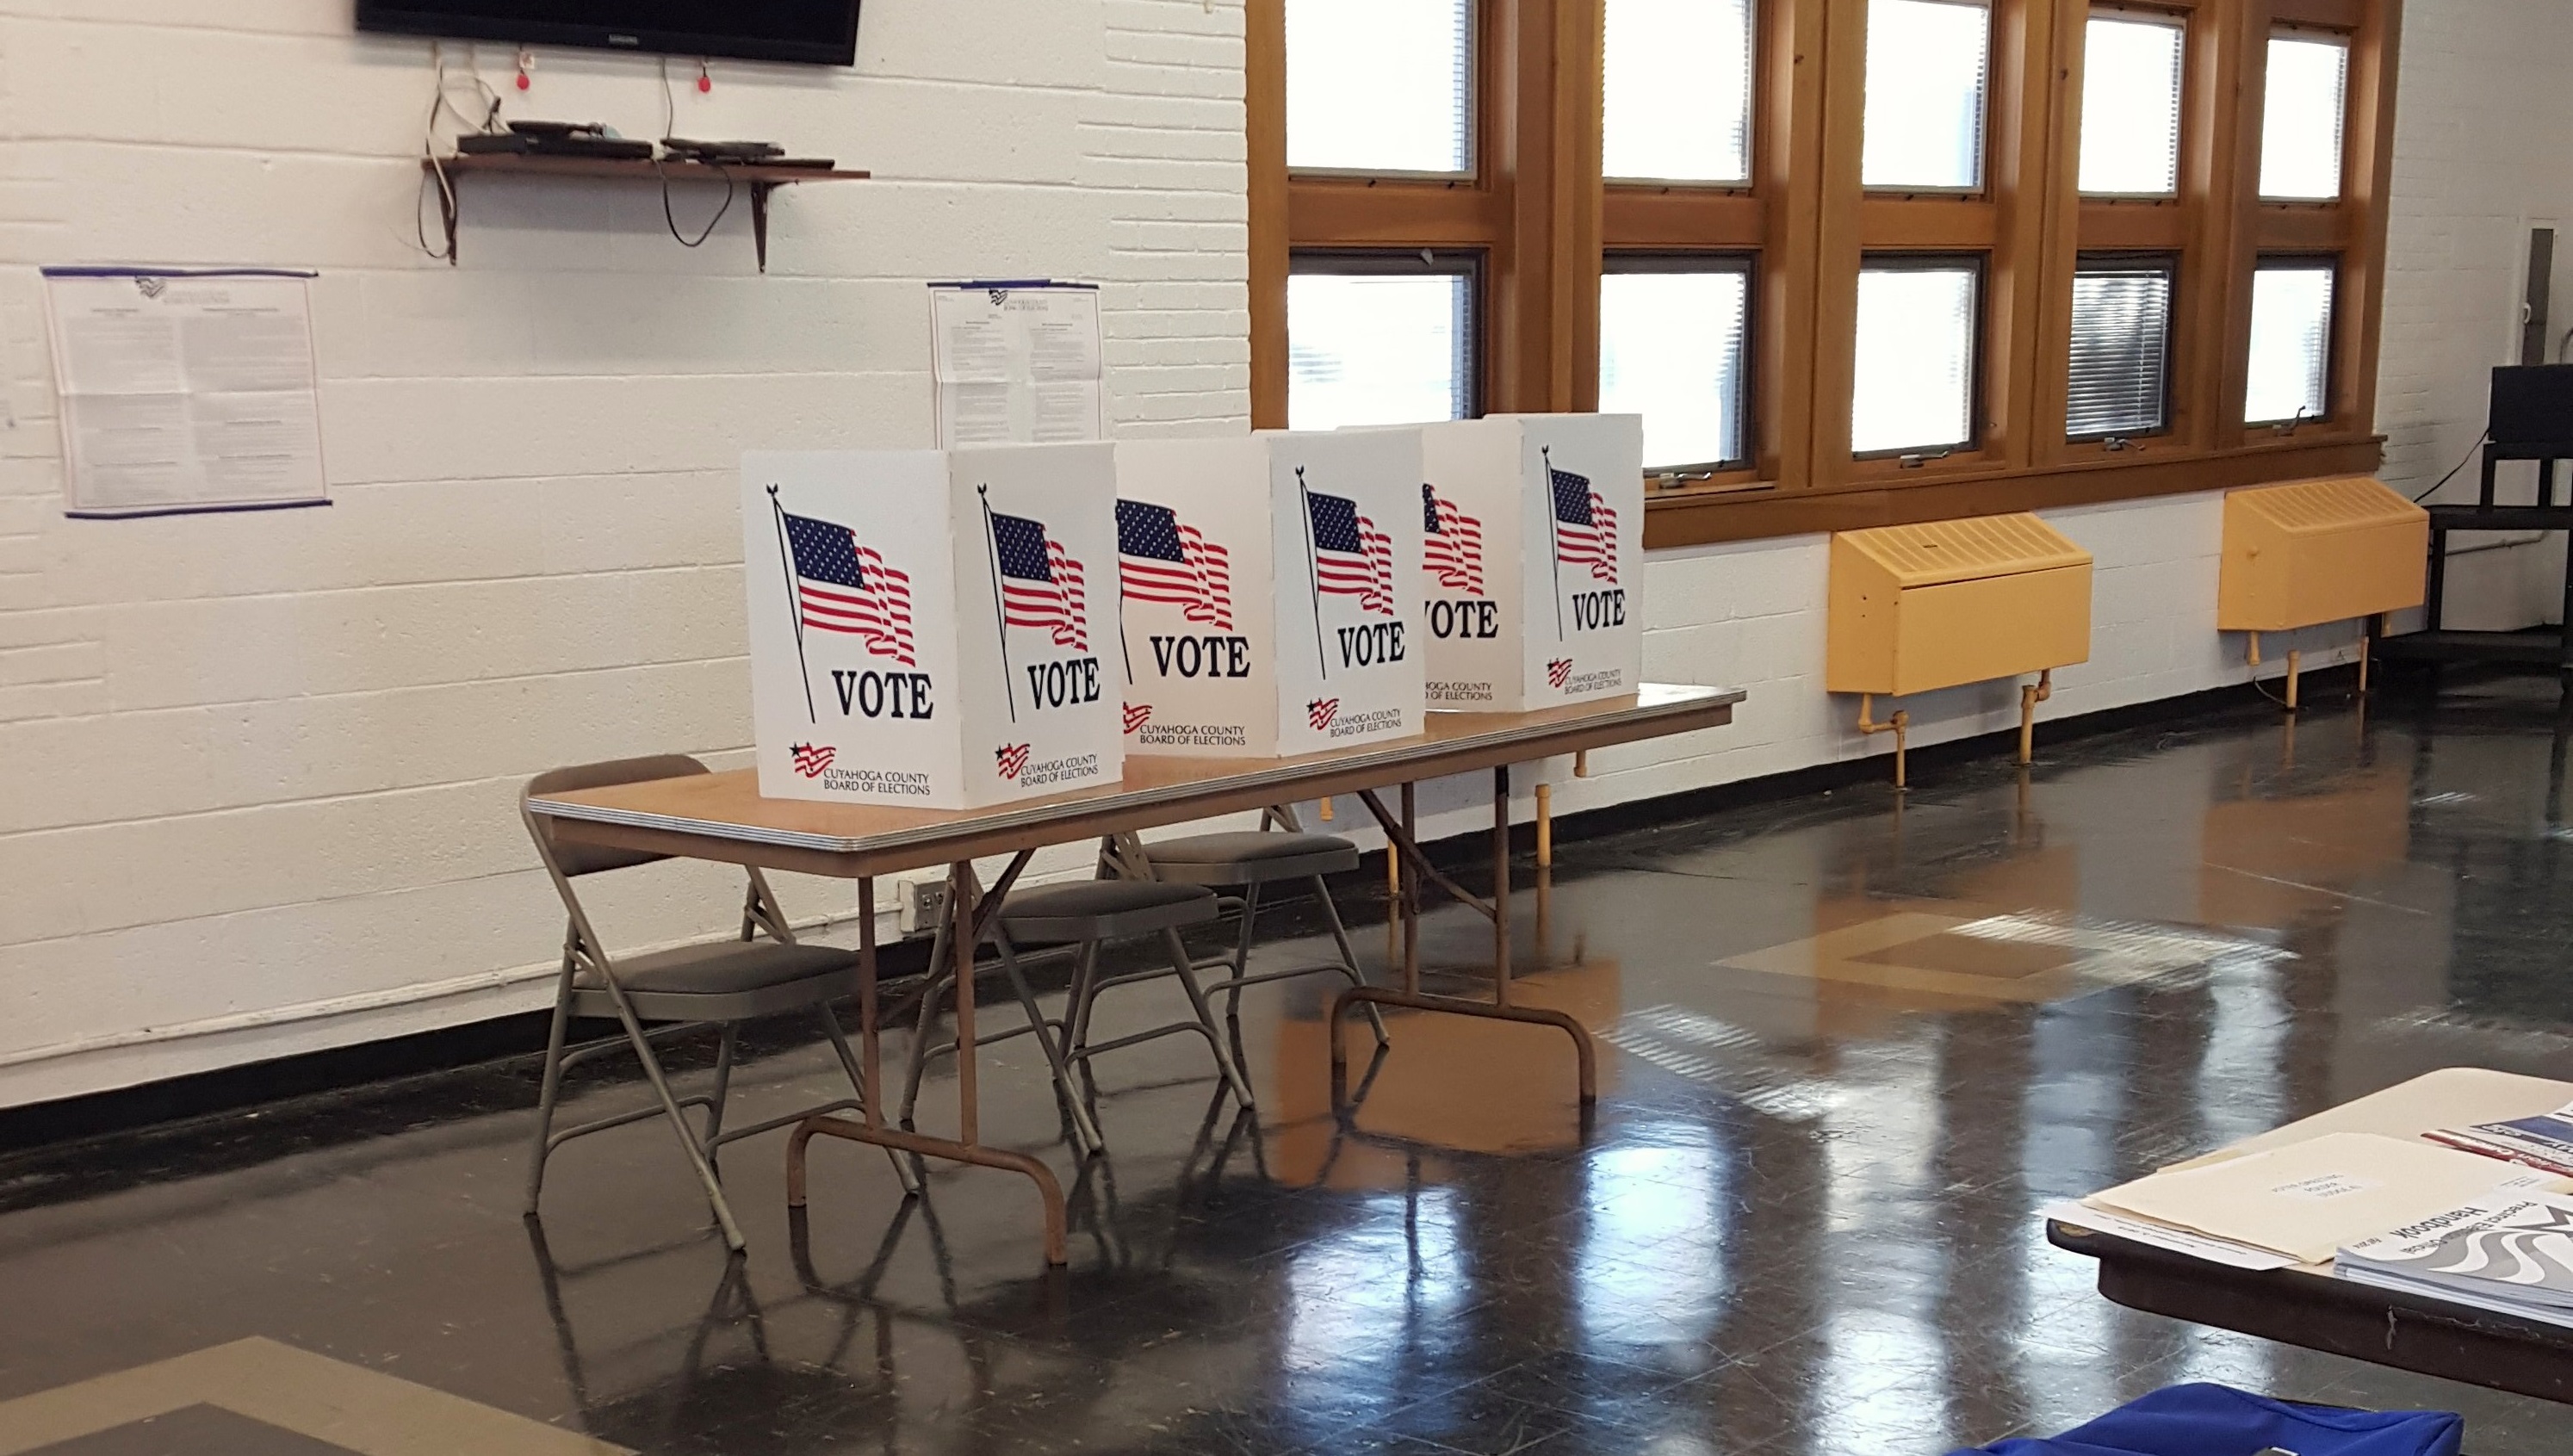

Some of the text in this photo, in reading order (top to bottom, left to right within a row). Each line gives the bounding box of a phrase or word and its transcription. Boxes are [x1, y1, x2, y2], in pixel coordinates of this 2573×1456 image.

[1425, 599, 1498, 639] OTE
[1572, 588, 1626, 631] VOTE
[1150, 635, 1250, 678] VOTE
[1337, 621, 1405, 669] VOTE
[832, 670, 934, 720] VOTE
[1027, 657, 1100, 710] VOTE
[1452, 682, 1492, 691] COUNTY
[1430, 691, 1442, 700] OF
[1445, 691, 1493, 701] ELECTIONS
[1139, 724, 1245, 736] CUYAHOGA COUNTY
[1330, 709, 1401, 728] CUYAHOGA COUNTY
[1330, 718, 1402, 738] BOARD OF ELECTIONS
[1140, 734, 1246, 747] BOARD OF ELECTIONS
[823, 768, 930, 784] CUYAHOGA COUNTY
[1020, 753, 1098, 777] CUYAHOGA COUNTY
[1020, 765, 1099, 788] BOARD OF ELECTIONS
[824, 779, 931, 796] BOARD OF ELECTIONS
[2389, 1206, 2489, 1240] Handbook
